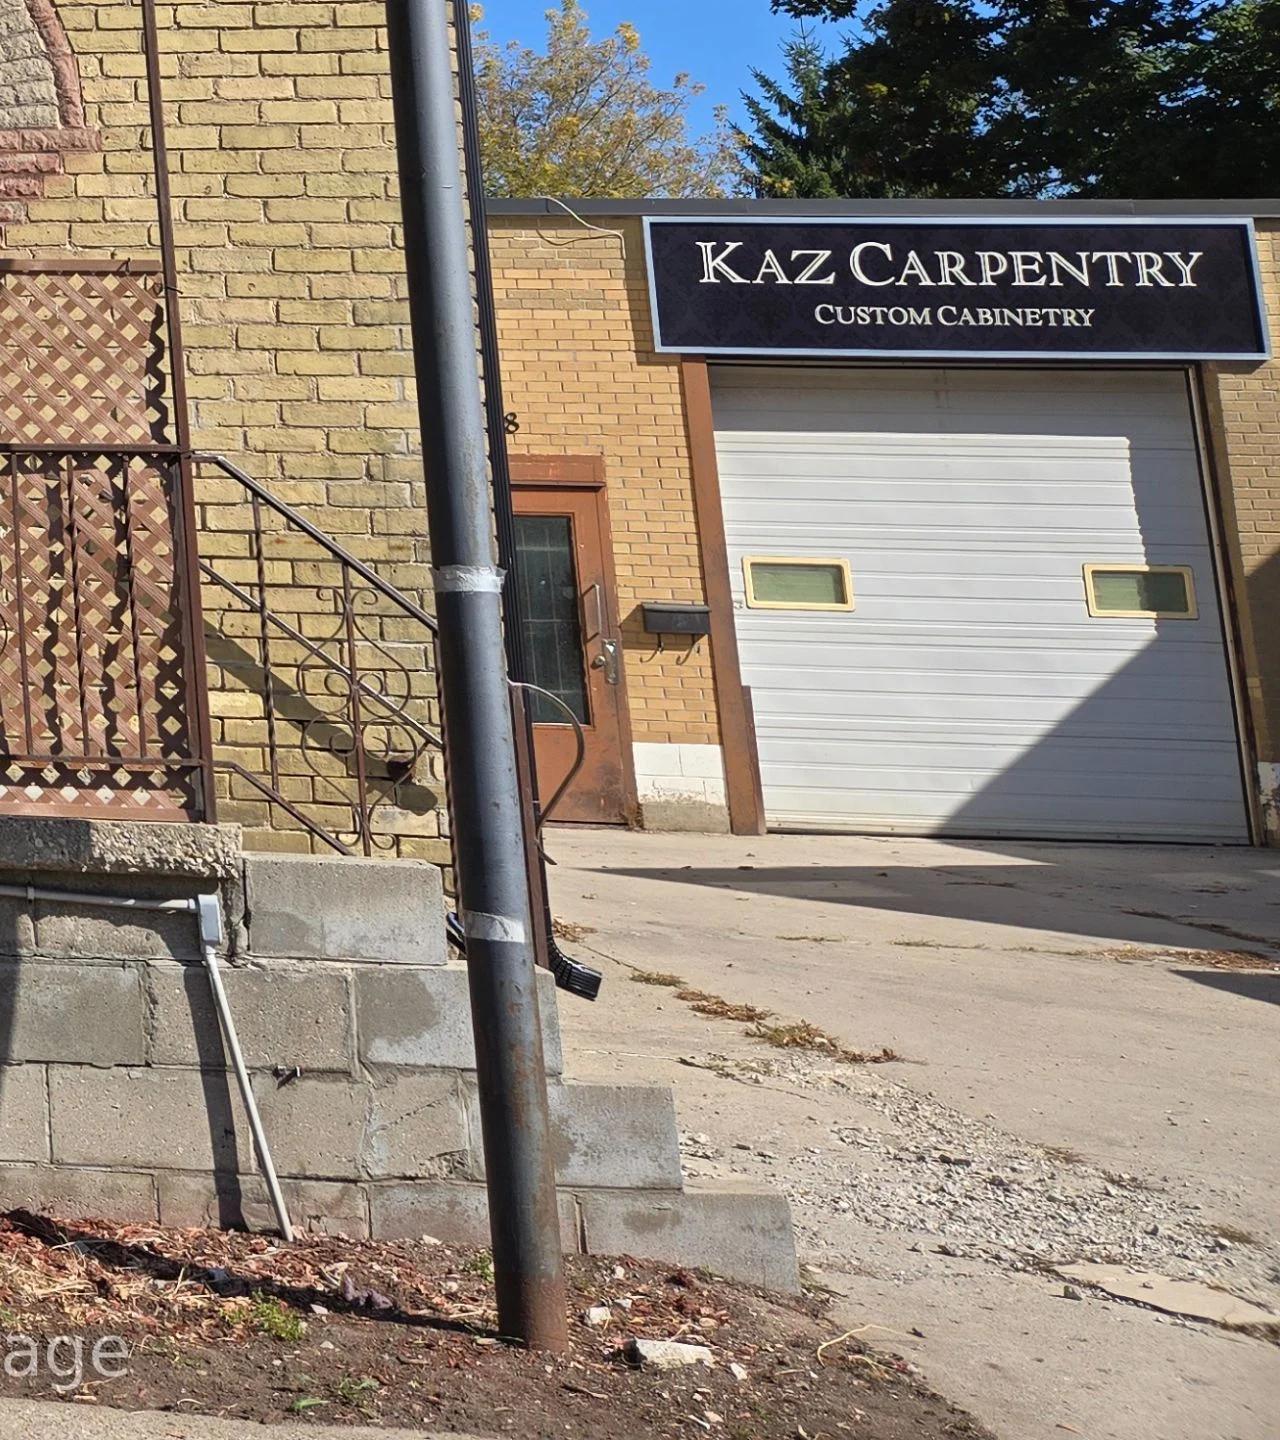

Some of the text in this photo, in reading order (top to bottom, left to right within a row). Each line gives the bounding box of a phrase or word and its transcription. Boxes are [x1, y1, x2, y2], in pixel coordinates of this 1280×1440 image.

[695, 241, 1204, 287] KAZ CARPENTRY
[814, 303, 1096, 327] CUSTOM CABINETRY
